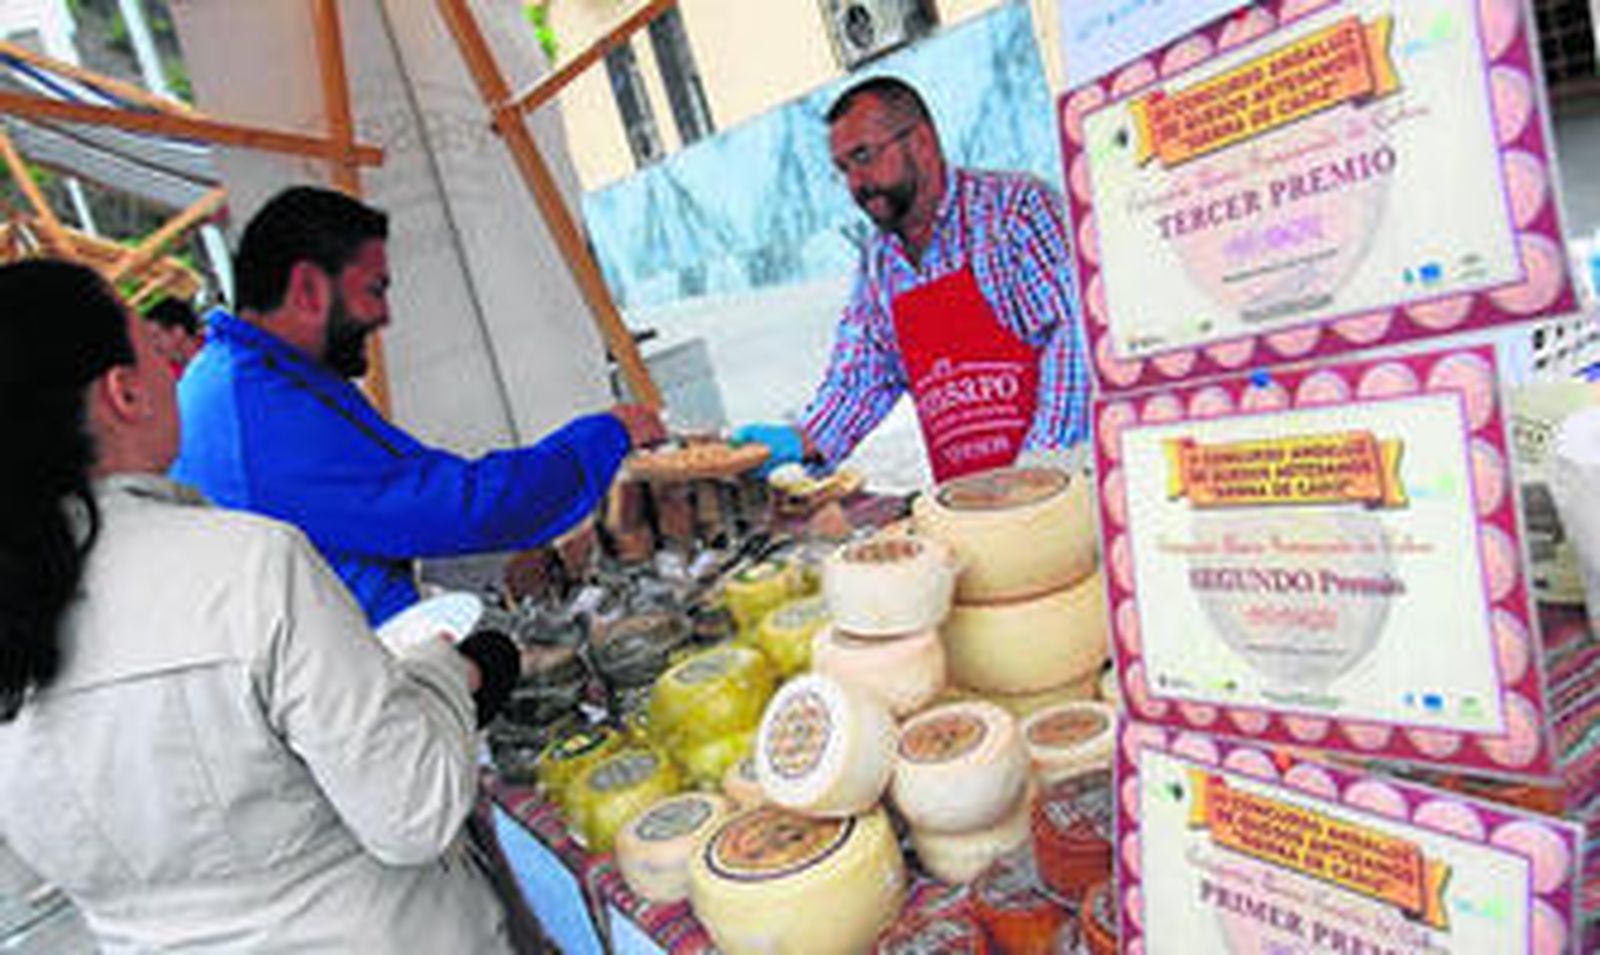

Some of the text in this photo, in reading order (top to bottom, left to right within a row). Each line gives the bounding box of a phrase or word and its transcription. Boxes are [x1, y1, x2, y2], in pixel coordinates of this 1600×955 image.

[1155, 190, 1263, 240] TERCER
[1268, 145, 1397, 208] PREMIO
[1189, 567, 1315, 593] SEGUNDO
[1200, 880, 1303, 933] PRIMER
